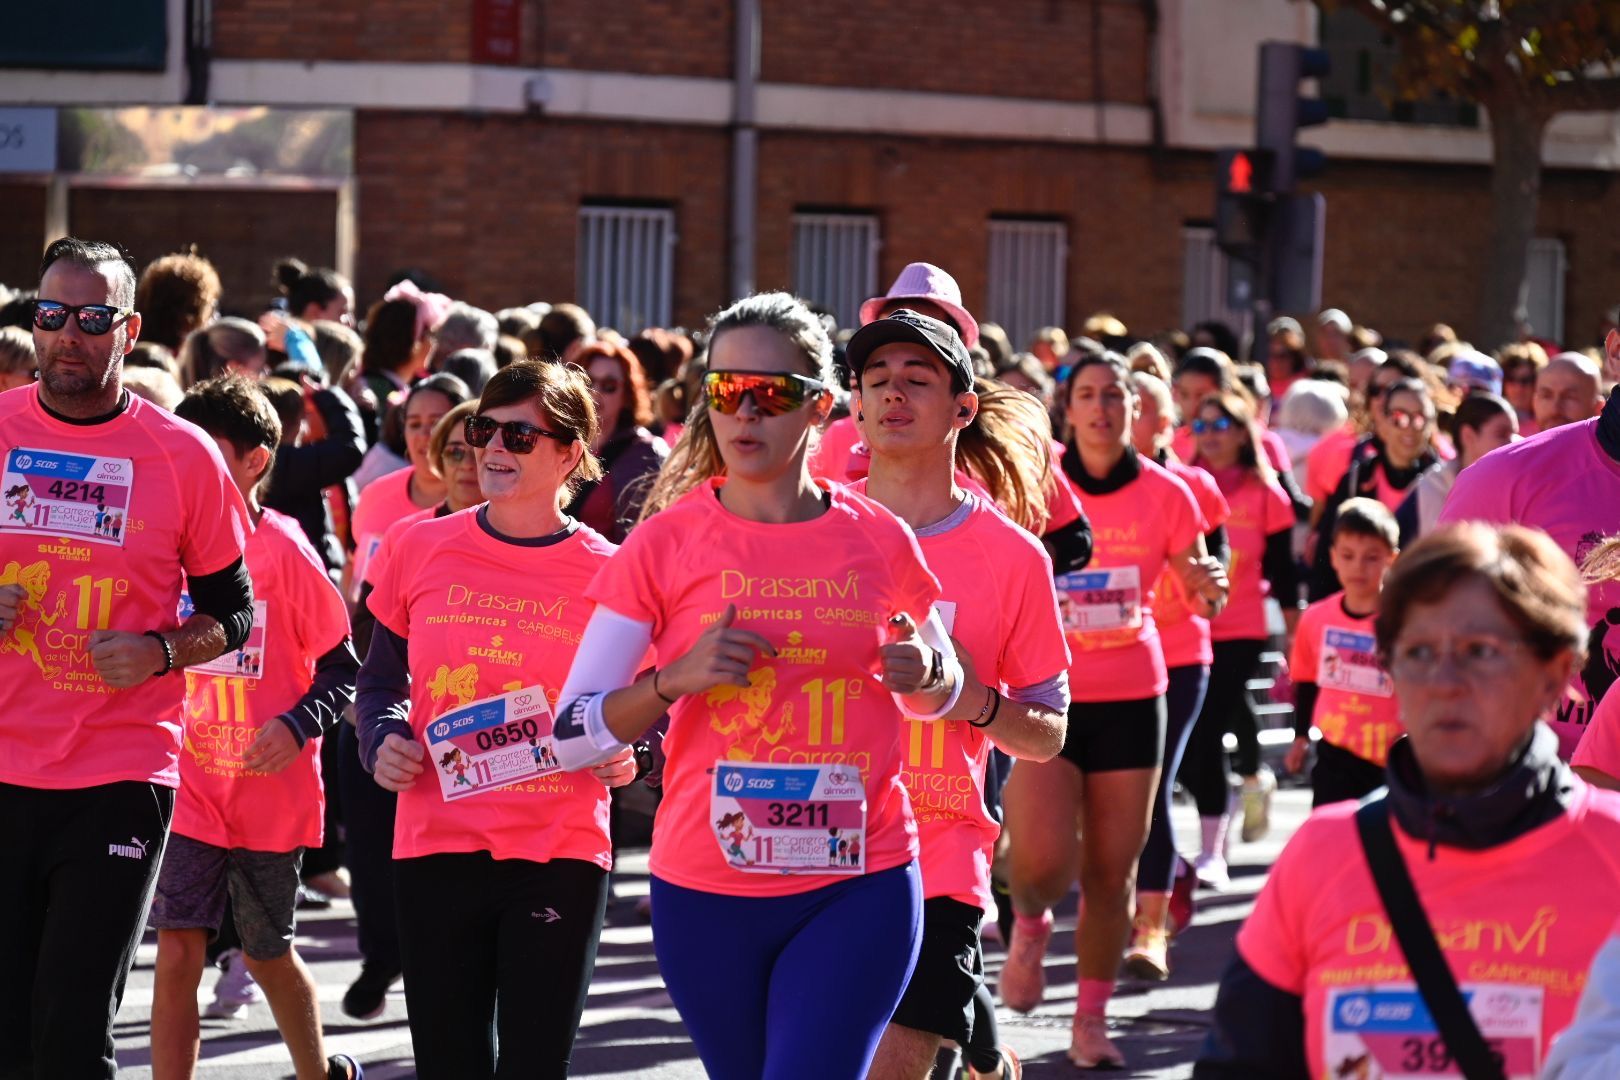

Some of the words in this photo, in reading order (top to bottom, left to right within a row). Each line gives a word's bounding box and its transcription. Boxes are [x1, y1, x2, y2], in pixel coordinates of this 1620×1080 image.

[48, 480, 105, 503] 4214
[63, 514, 94, 525] Mujer
[38, 545, 91, 557] SUZUKI
[721, 569, 859, 600] Drasanvi
[447, 584, 570, 620] Drasanvi
[517, 620, 583, 644] CAROBELS
[468, 646, 524, 662] SUZUKI
[53, 681, 116, 694] DRASAN
[476, 719, 538, 751] 0650
[900, 770, 972, 793] arrera
[767, 803, 829, 827] 3211
[109, 844, 142, 860] PUMA
